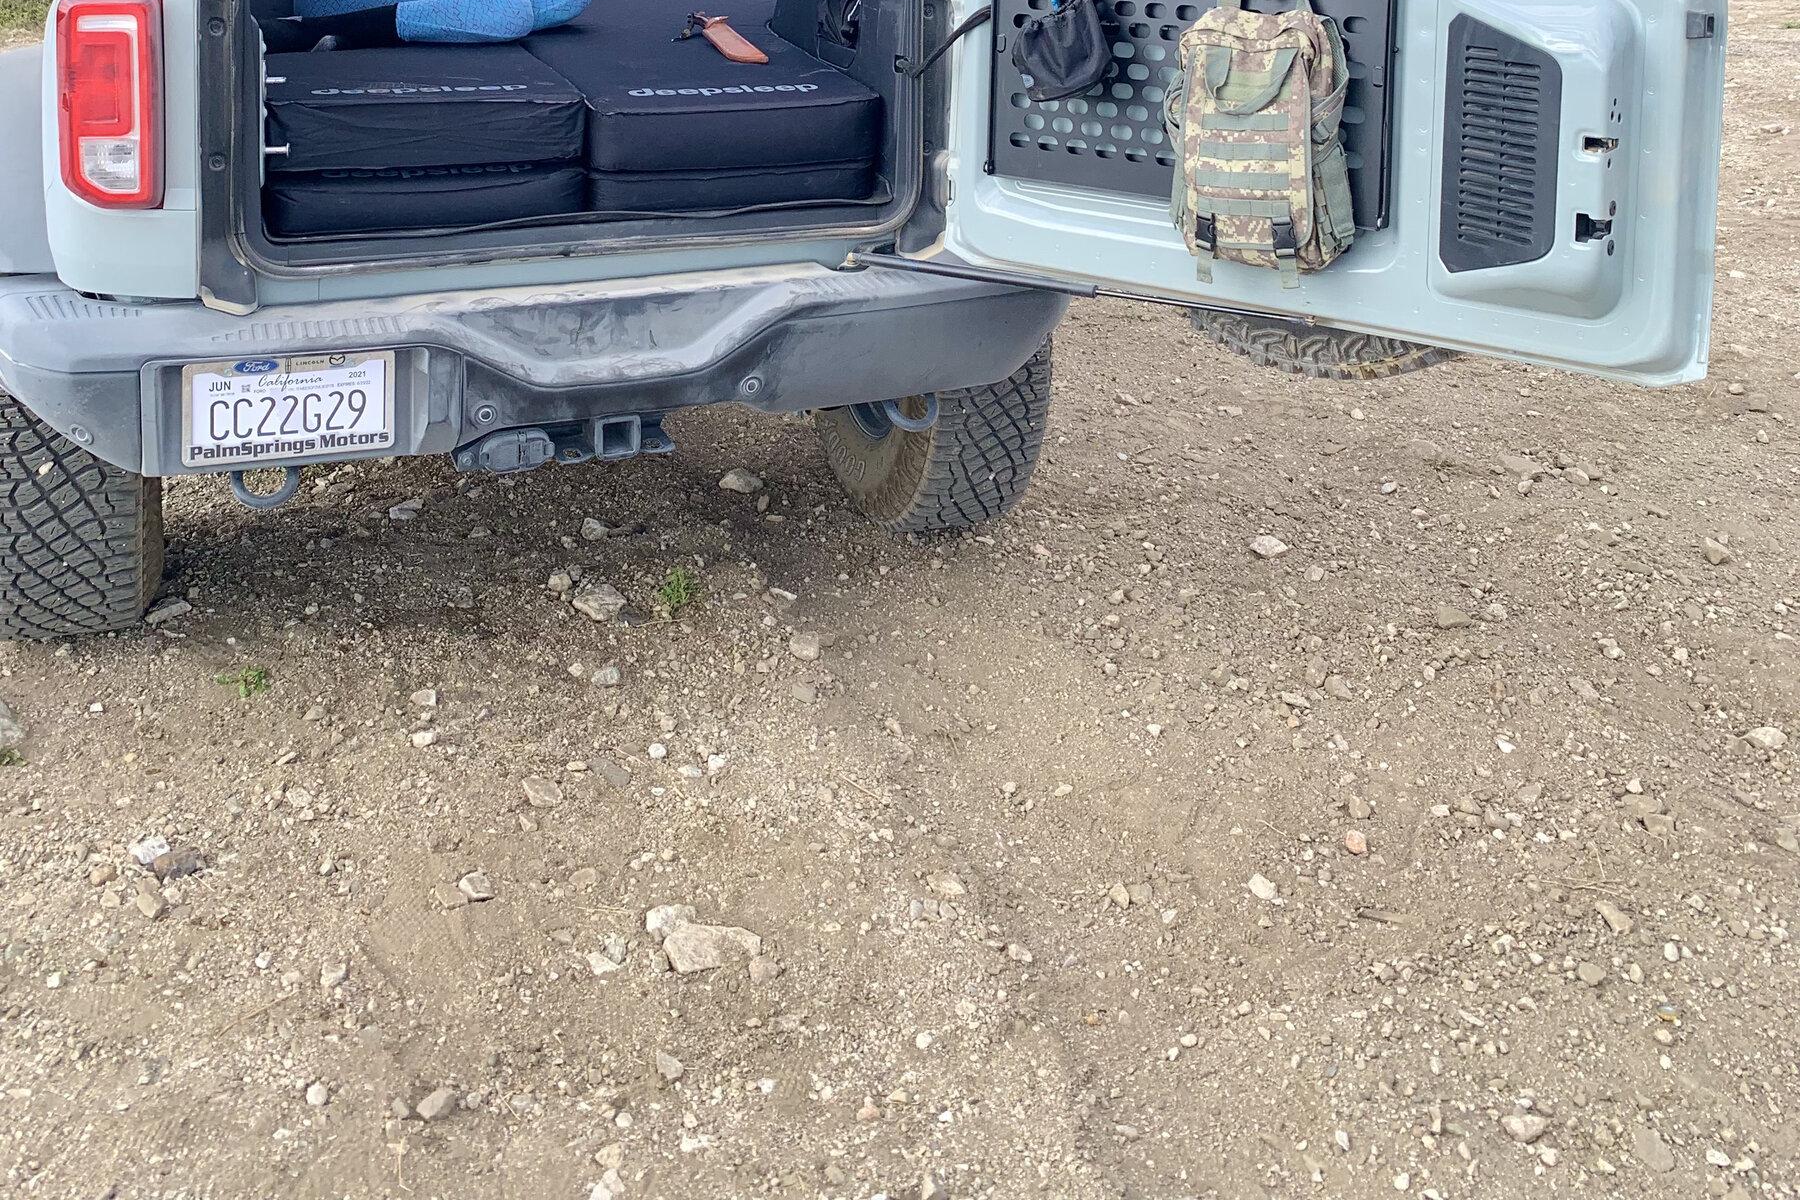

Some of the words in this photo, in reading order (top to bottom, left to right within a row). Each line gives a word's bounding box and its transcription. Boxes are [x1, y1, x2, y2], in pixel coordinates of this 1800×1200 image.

[311, 84, 528, 95] deepsleep
[627, 83, 819, 97] deepsleep
[242, 361, 270, 372] Ford
[348, 370, 367, 379] 2021
[209, 381, 231, 392] JUN
[258, 372, 323, 392] California
[209, 389, 367, 441] CC22G29
[190, 439, 316, 460] PalmSprings
[320, 431, 390, 449] Motors
